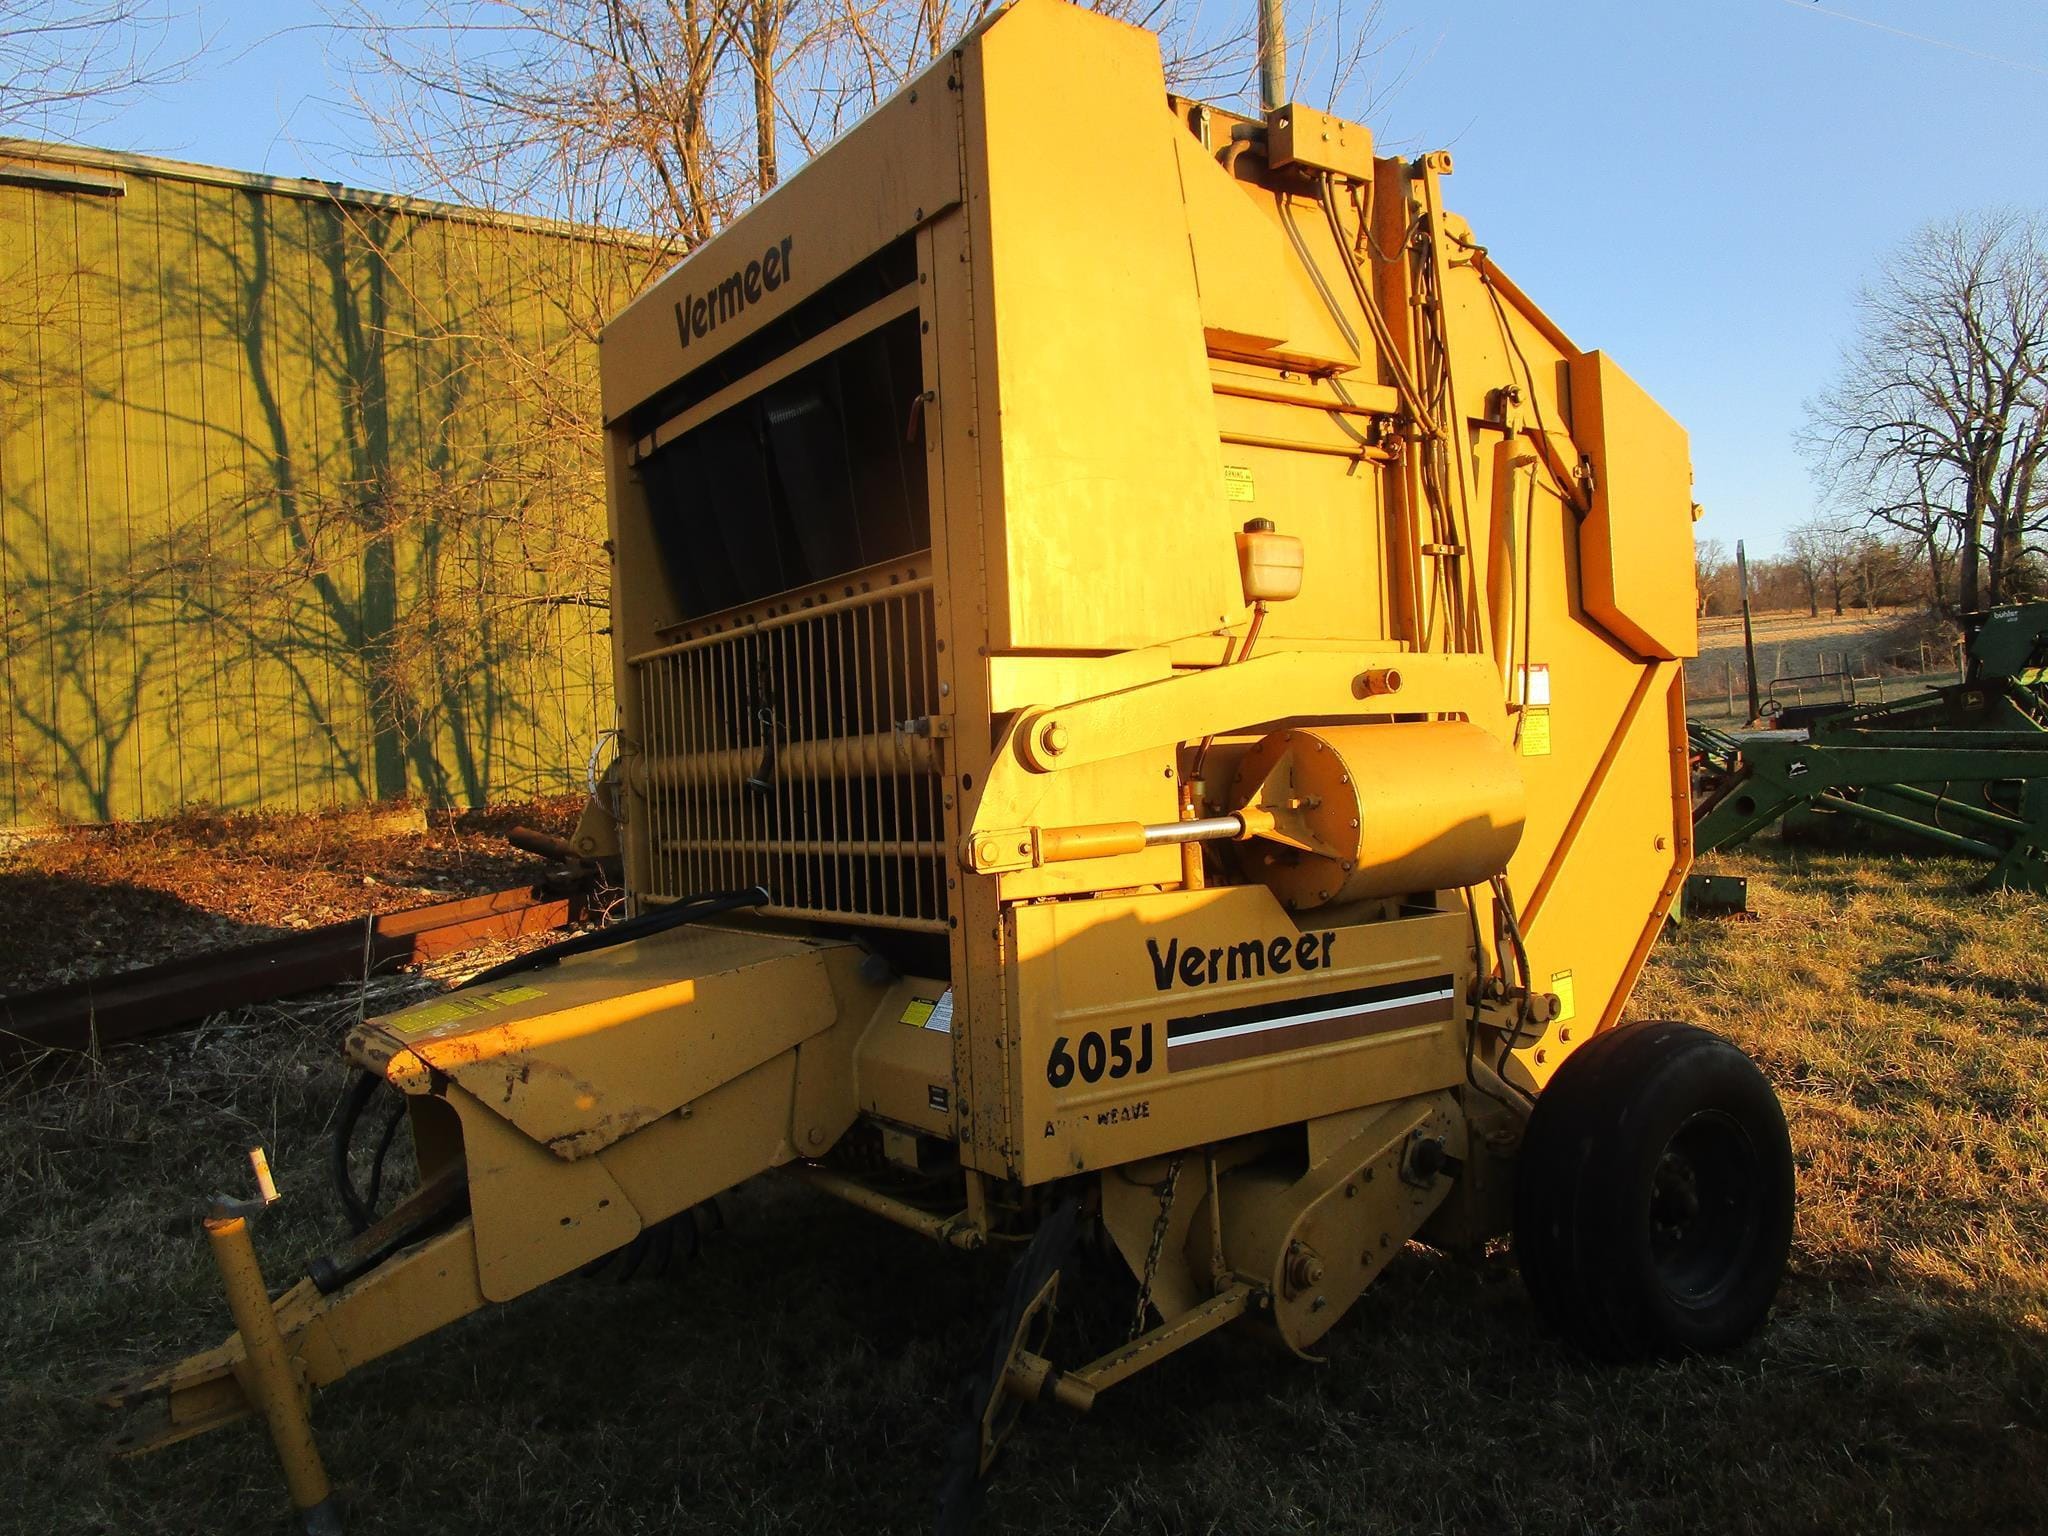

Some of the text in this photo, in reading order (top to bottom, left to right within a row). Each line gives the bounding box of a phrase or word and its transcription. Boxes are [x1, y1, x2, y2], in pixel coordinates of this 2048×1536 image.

[674, 235, 793, 349] Vermeer
[1145, 931, 1337, 991] Vermeer
[1046, 1022, 1153, 1089] 605J
[1097, 1100, 1150, 1125] WEAVE
